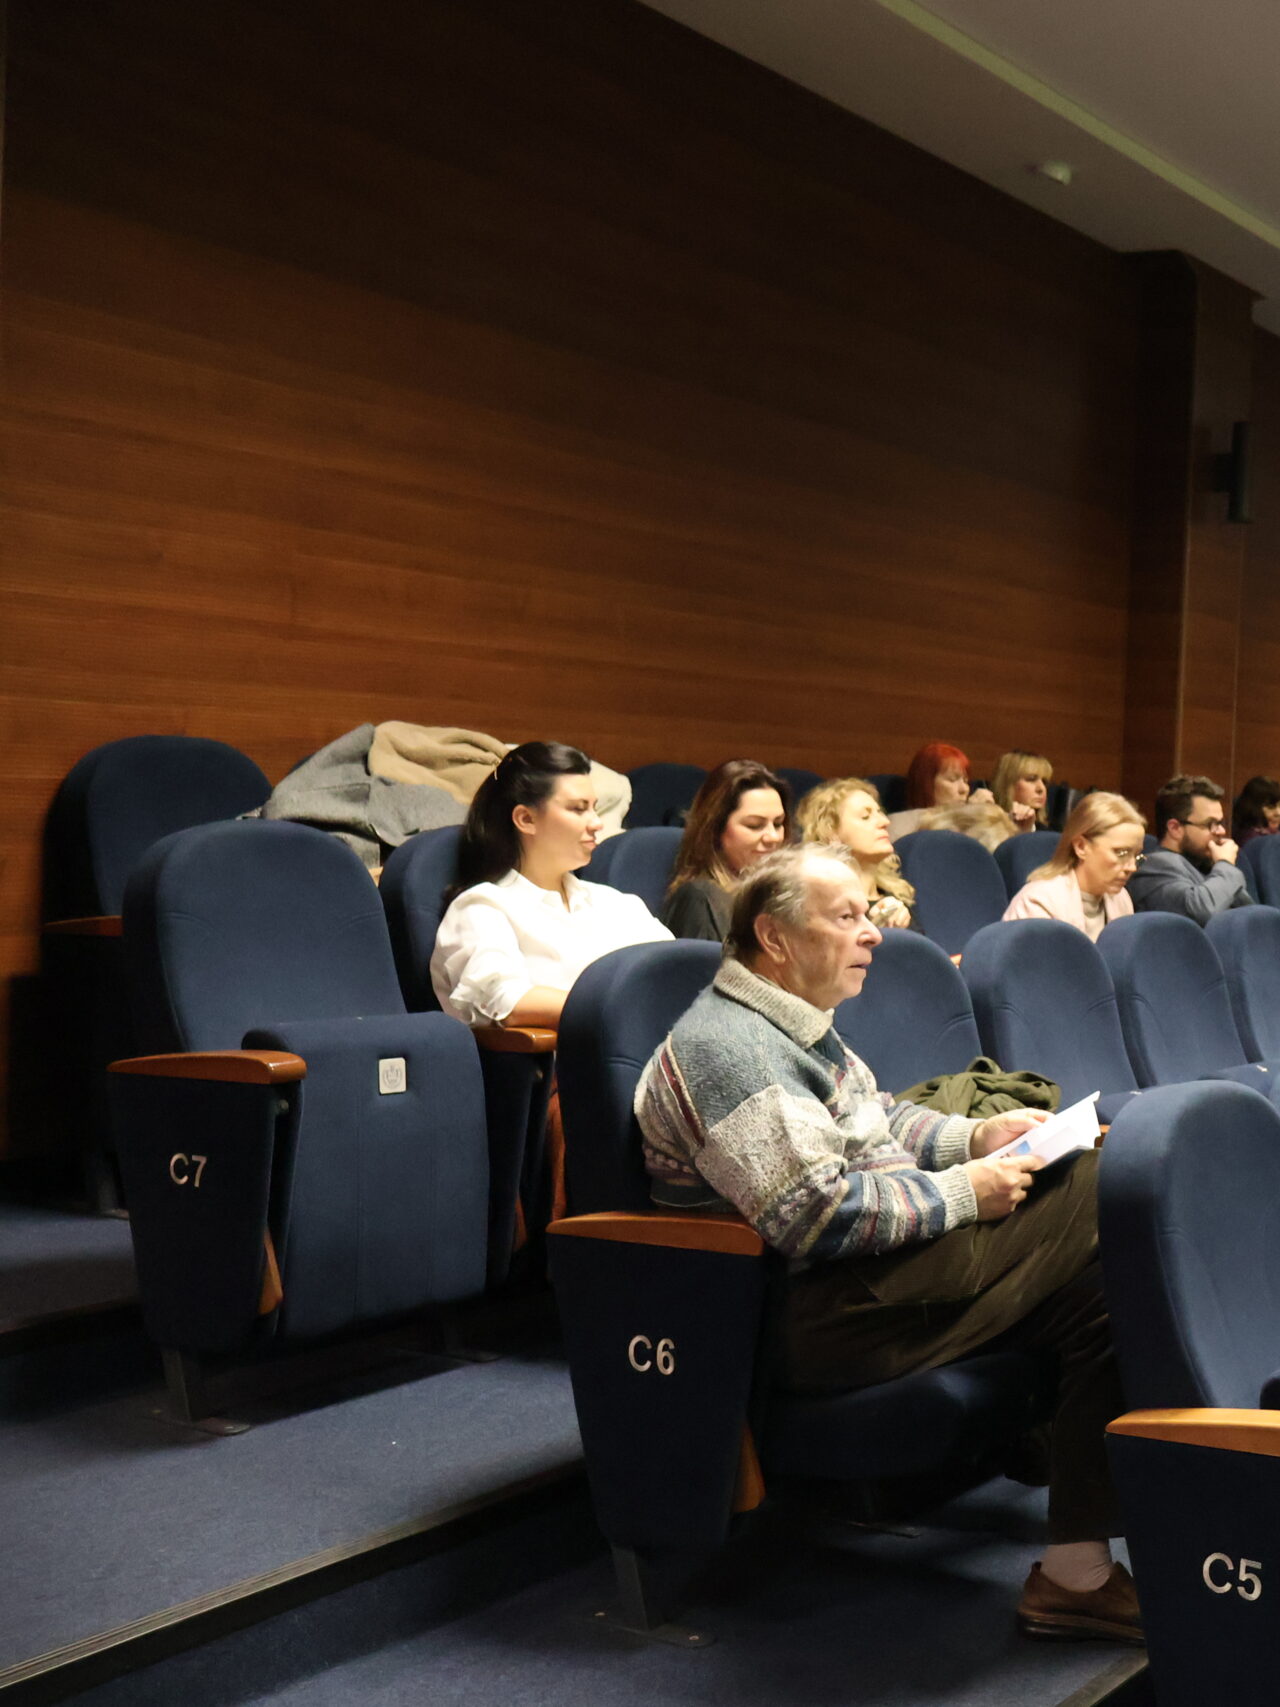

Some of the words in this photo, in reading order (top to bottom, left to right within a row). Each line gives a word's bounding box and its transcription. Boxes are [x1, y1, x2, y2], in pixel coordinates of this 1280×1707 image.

[170, 1153, 206, 1187] C7
[628, 1335, 675, 1375] C6
[1202, 1552, 1262, 1601] C5
